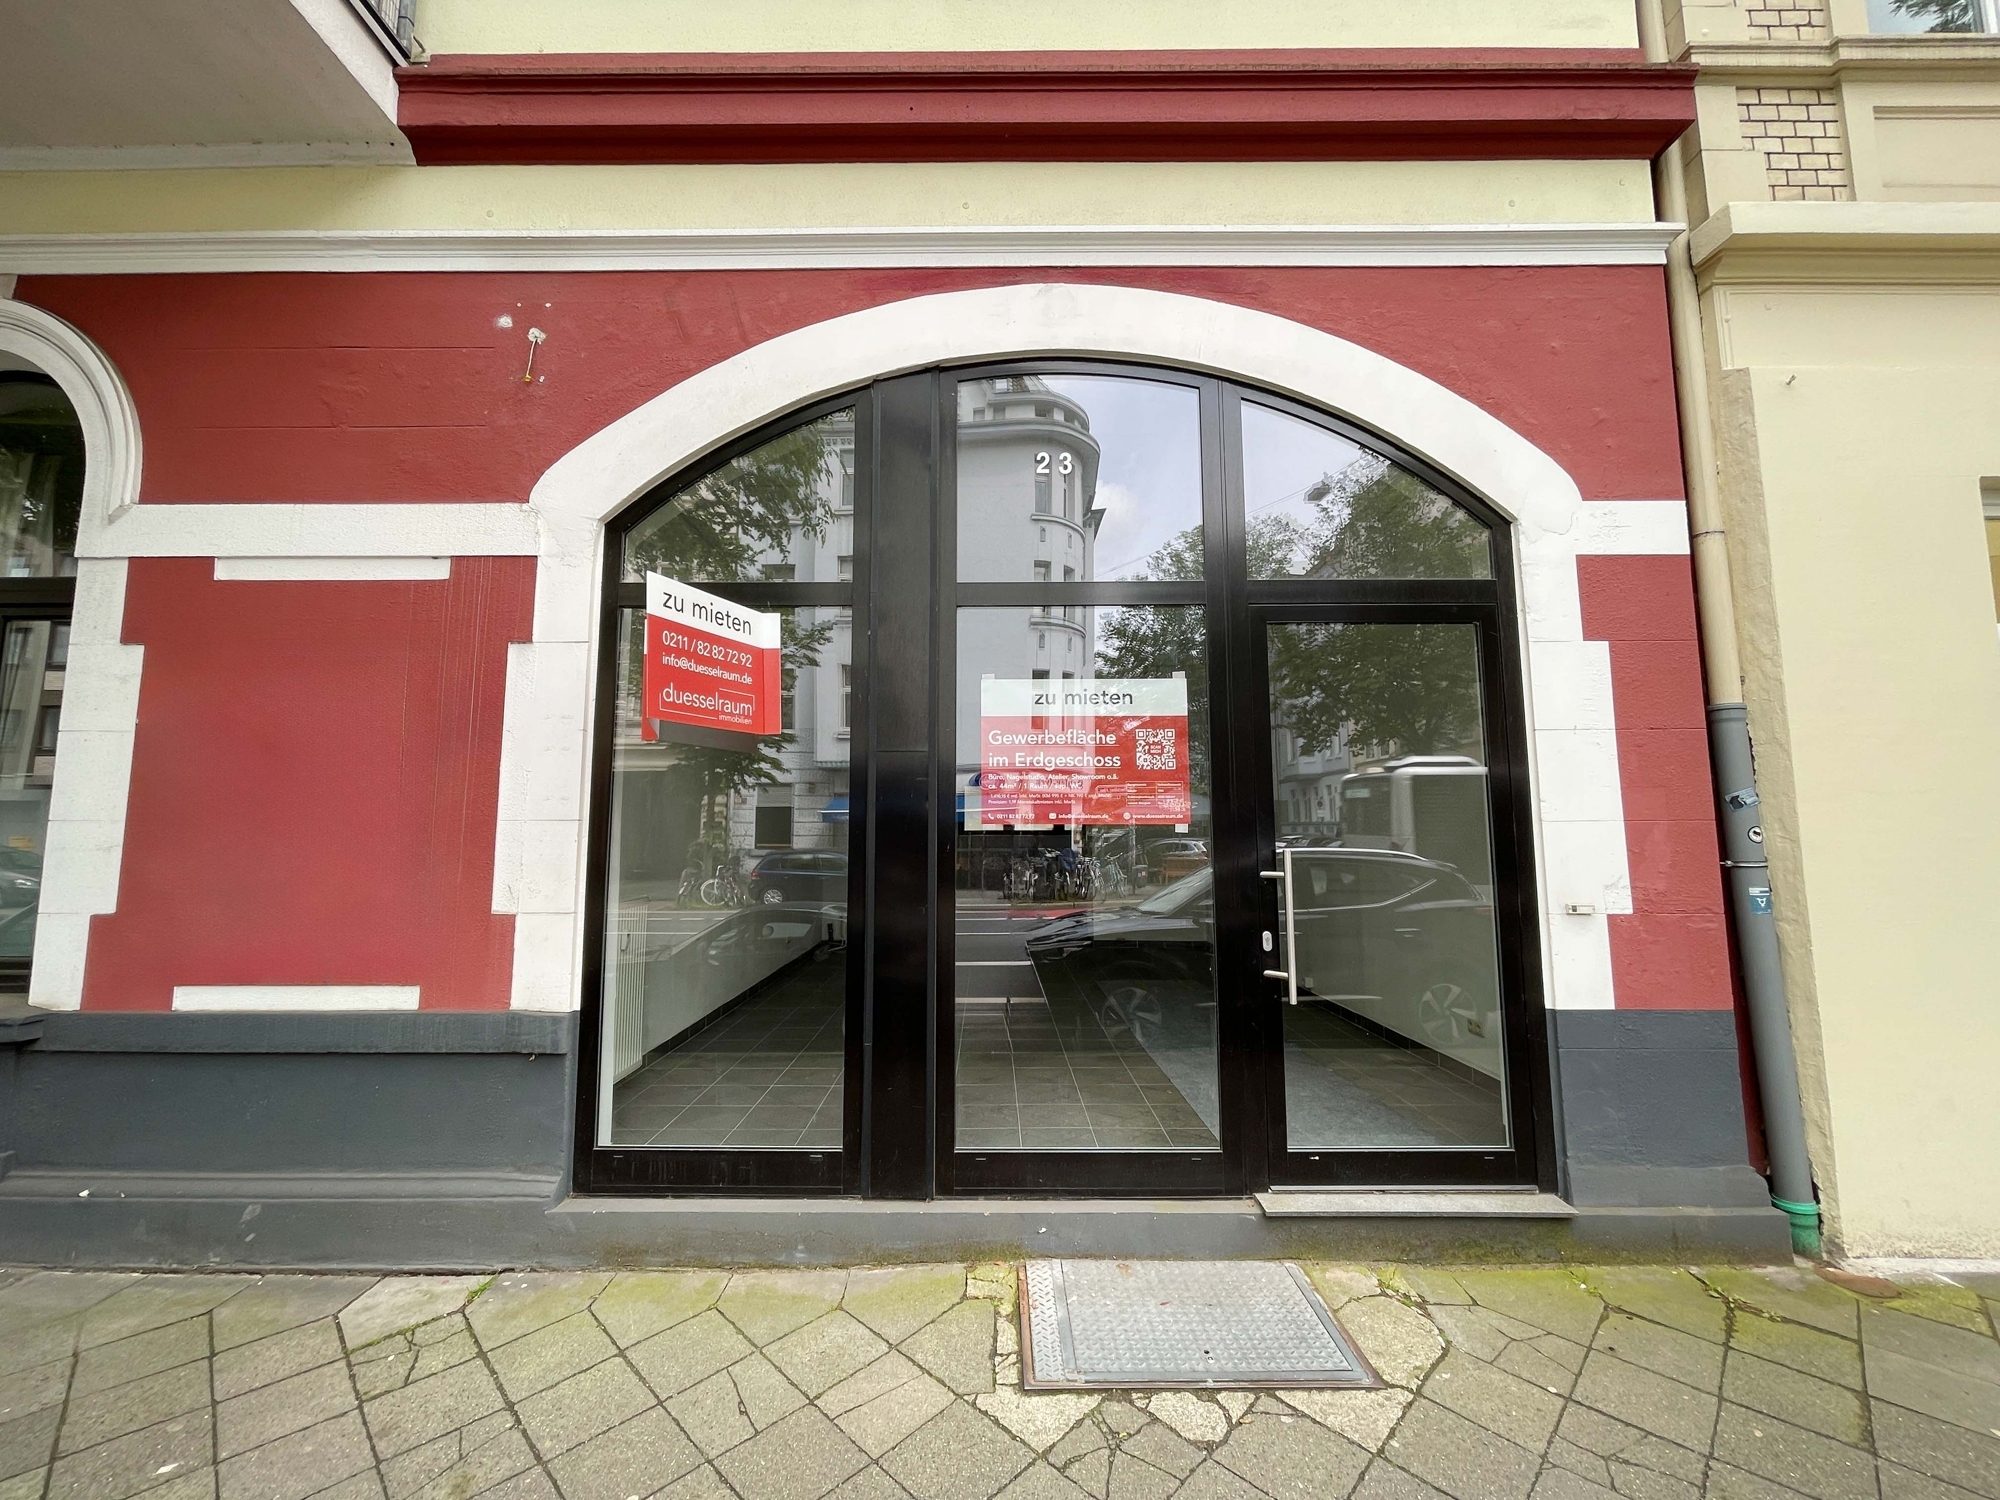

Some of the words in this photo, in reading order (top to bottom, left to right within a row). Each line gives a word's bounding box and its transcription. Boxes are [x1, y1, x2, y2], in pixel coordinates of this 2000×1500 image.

[1036, 451, 1073, 475] 23
[662, 591, 684, 614] zu
[692, 602, 752, 636] mieten
[662, 630, 688, 651] 0211
[662, 652, 753, 685] info@duesselraum.de
[662, 682, 753, 717] duesselraum
[1034, 692, 1056, 705] zu
[1064, 688, 1133, 705] mieten
[718, 713, 753, 725] immobilien
[988, 729, 1117, 746] Gewerbefläche
[988, 752, 1009, 767] im
[1015, 752, 1121, 771] Erdgeschoss
